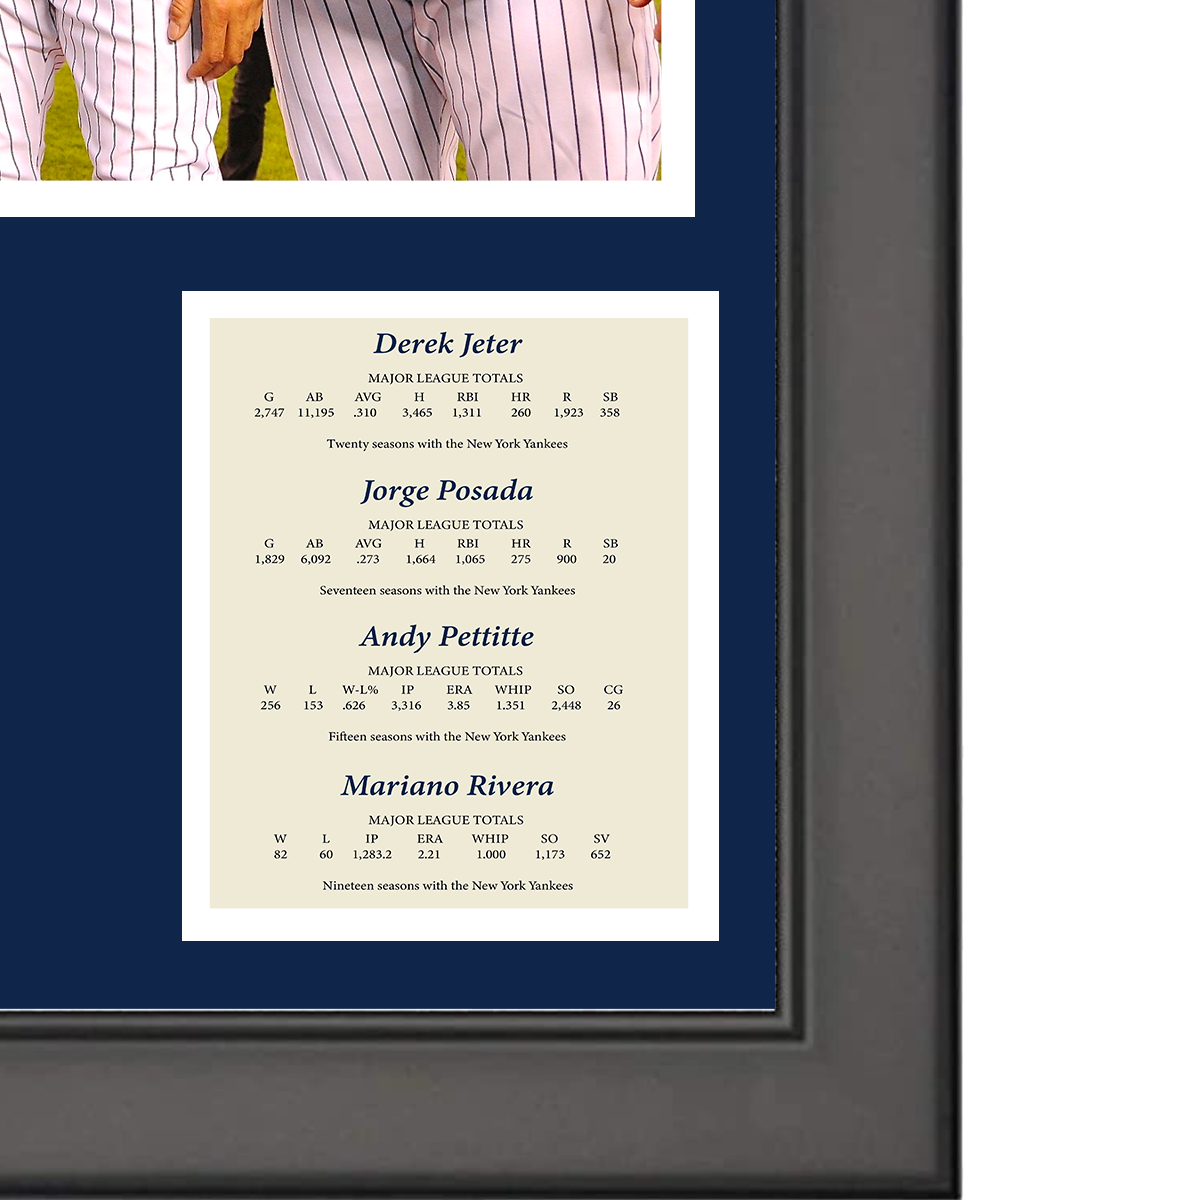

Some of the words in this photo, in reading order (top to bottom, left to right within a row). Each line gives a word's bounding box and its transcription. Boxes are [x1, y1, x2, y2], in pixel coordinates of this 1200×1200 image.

[372, 331, 455, 354] Derek
[458, 332, 524, 359] Jeter
[368, 372, 414, 386] MAJOR
[416, 372, 470, 384] LEAGUE
[471, 372, 524, 384] TOTALS
[263, 391, 274, 403] G
[305, 391, 324, 402] AB
[354, 391, 382, 403] AVG
[414, 391, 425, 402] H
[456, 391, 479, 402] RBI
[511, 391, 532, 402] HR
[562, 391, 572, 402] R
[602, 391, 619, 403] SB
[254, 407, 285, 419] 2,747
[298, 407, 335, 419] 11,195
[353, 407, 377, 418] .310
[402, 407, 433, 419] 3,465
[452, 407, 482, 419] 1,311
[510, 407, 532, 418] 260
[554, 407, 584, 419] 1,923
[599, 407, 621, 418] 358
[326, 438, 370, 452] Twenty
[371, 441, 415, 449] seasons
[417, 438, 443, 449] with
[445, 438, 464, 449] the
[466, 438, 493, 449] New
[494, 438, 521, 449] York
[522, 438, 569, 449] Yankees
[359, 479, 430, 508] Jorge
[435, 477, 534, 501] Posada
[368, 519, 415, 532] MAJOR
[417, 519, 470, 530] LEAGUE
[472, 519, 524, 530] TOTALS
[263, 538, 275, 549] G
[305, 538, 324, 549] AB
[354, 538, 382, 549] AVG
[414, 538, 425, 549] H
[457, 538, 479, 549] RBI
[511, 538, 532, 549] HR
[563, 538, 572, 549] R
[602, 538, 619, 549] SB
[255, 554, 285, 566] 1,829
[300, 554, 332, 566] 6,092
[356, 554, 380, 565] .273
[406, 554, 436, 566] 1,664
[456, 554, 486, 566] 1,065
[510, 554, 532, 565] 275
[556, 554, 578, 565] 900
[602, 554, 617, 565] 20
[319, 585, 377, 596] Seventeen
[379, 587, 423, 596] seasons
[424, 584, 451, 596] with
[453, 584, 472, 596] the
[473, 585, 501, 596] New
[502, 584, 529, 596] York
[530, 584, 576, 596] Yankees
[357, 623, 432, 654] Andy
[437, 625, 535, 647] Pettitte
[367, 665, 414, 678] MAJOR
[416, 665, 470, 676] LEAGUE
[471, 665, 524, 676] TOTALS
[263, 684, 278, 695] W
[308, 684, 317, 695] L
[342, 684, 379, 695] W-L%
[401, 684, 415, 695] IP
[446, 684, 473, 695] ERA
[494, 684, 532, 695] WHIP
[557, 684, 575, 695] SO
[603, 684, 624, 695] CG
[260, 700, 282, 711] 256
[304, 700, 324, 711] 153
[342, 700, 366, 711] .626
[391, 700, 422, 712] 3,316
[447, 700, 471, 711] 3.85
[496, 700, 525, 711] 1.351
[551, 700, 582, 712] 2,448
[607, 700, 621, 711] 26
[328, 730, 367, 742] Fifteen
[369, 733, 413, 742] seasons
[415, 730, 441, 742] with
[443, 730, 462, 742] the
[464, 731, 491, 742] New
[492, 730, 521, 742] York
[520, 730, 567, 742] Yankees
[339, 774, 460, 797] Mariano
[466, 774, 555, 796] Rivera
[368, 814, 415, 827] MAJOR
[417, 814, 471, 826] LEAGUE
[472, 814, 524, 826] TOTALS
[273, 833, 288, 844] W
[322, 833, 331, 844] L
[365, 833, 379, 844] IP
[417, 833, 444, 844] ERA
[471, 833, 509, 844] WHIP
[540, 833, 559, 844] SO
[593, 833, 611, 844] SV
[273, 849, 288, 860] 82
[319, 849, 334, 860] 60
[353, 849, 393, 861] 1,283.2
[417, 849, 440, 860] 2.21
[477, 849, 507, 860] 1.000
[536, 849, 566, 861] 1,173
[590, 849, 611, 860] 652
[322, 880, 375, 891] Nineteen
[376, 882, 420, 891] seasons
[422, 879, 448, 891] with
[450, 879, 469, 891] the
[471, 880, 499, 891] New
[499, 879, 527, 891] York
[528, 879, 574, 891] Yankees
